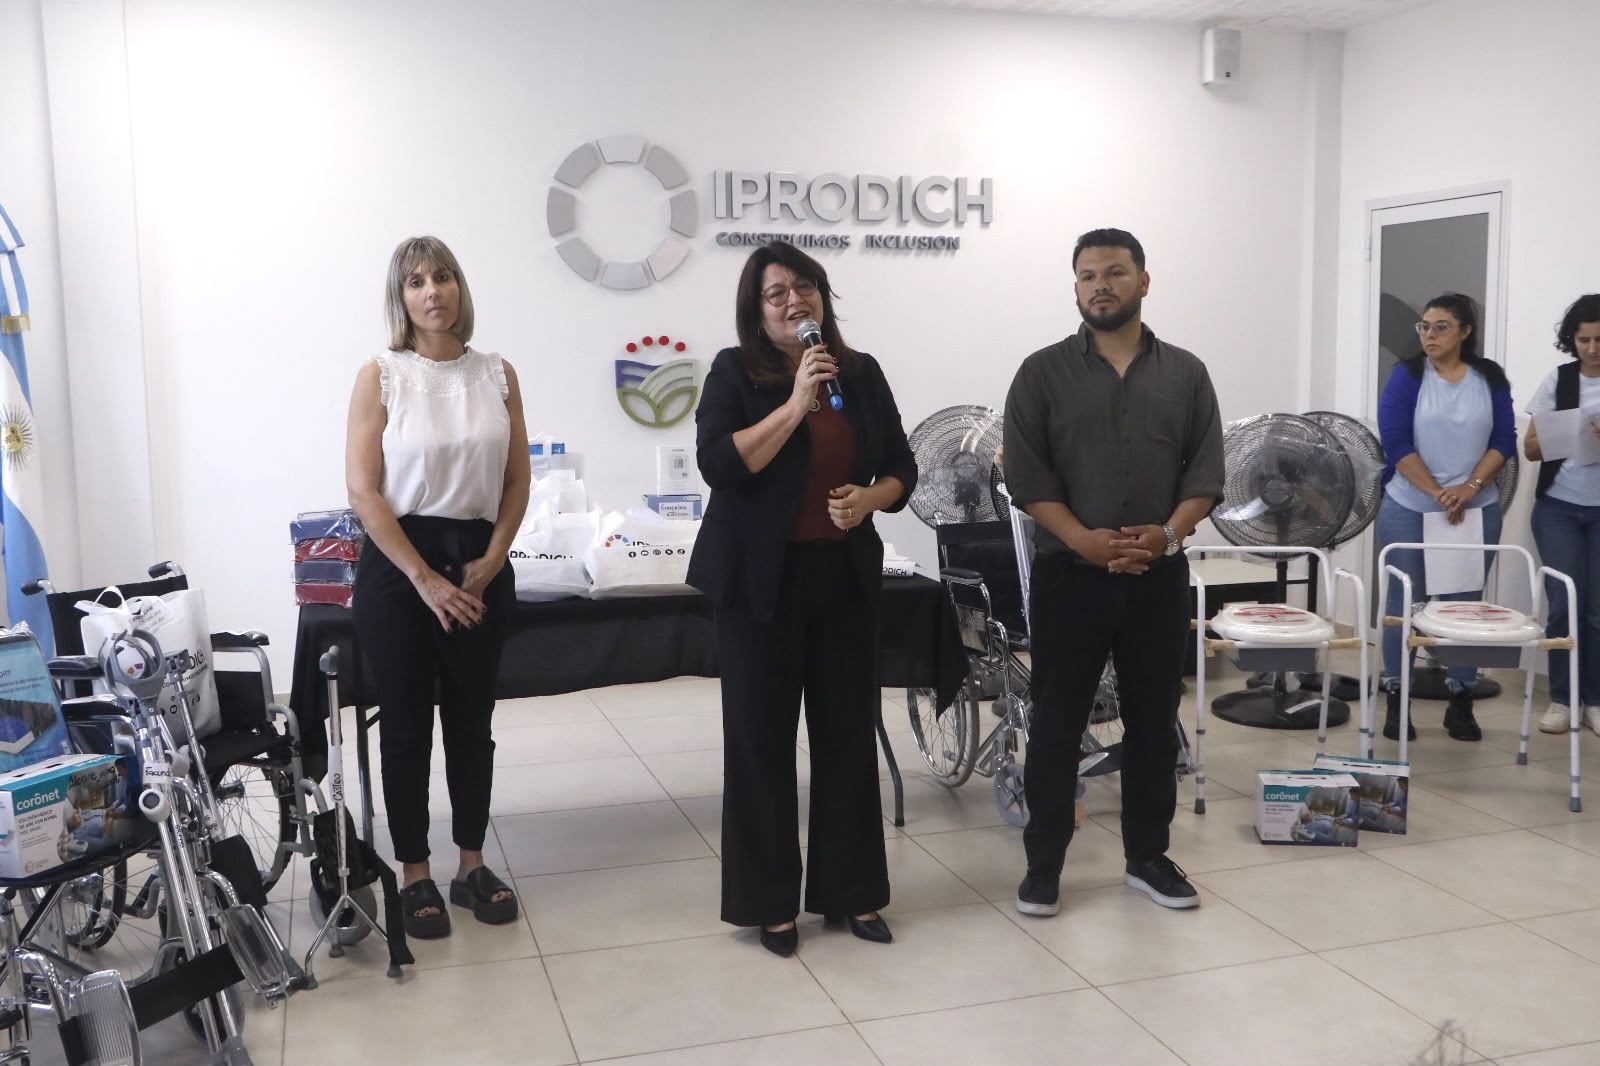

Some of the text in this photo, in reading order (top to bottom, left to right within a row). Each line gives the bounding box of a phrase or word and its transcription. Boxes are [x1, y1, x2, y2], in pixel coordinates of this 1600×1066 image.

[714, 170, 993, 223] IPRODICH
[716, 232, 960, 250] CONSTRUIMOS INCLUSION
[883, 567, 907, 577] ODICH
[16, 788, 60, 811] corônet
[1265, 791, 1300, 800] corônet
